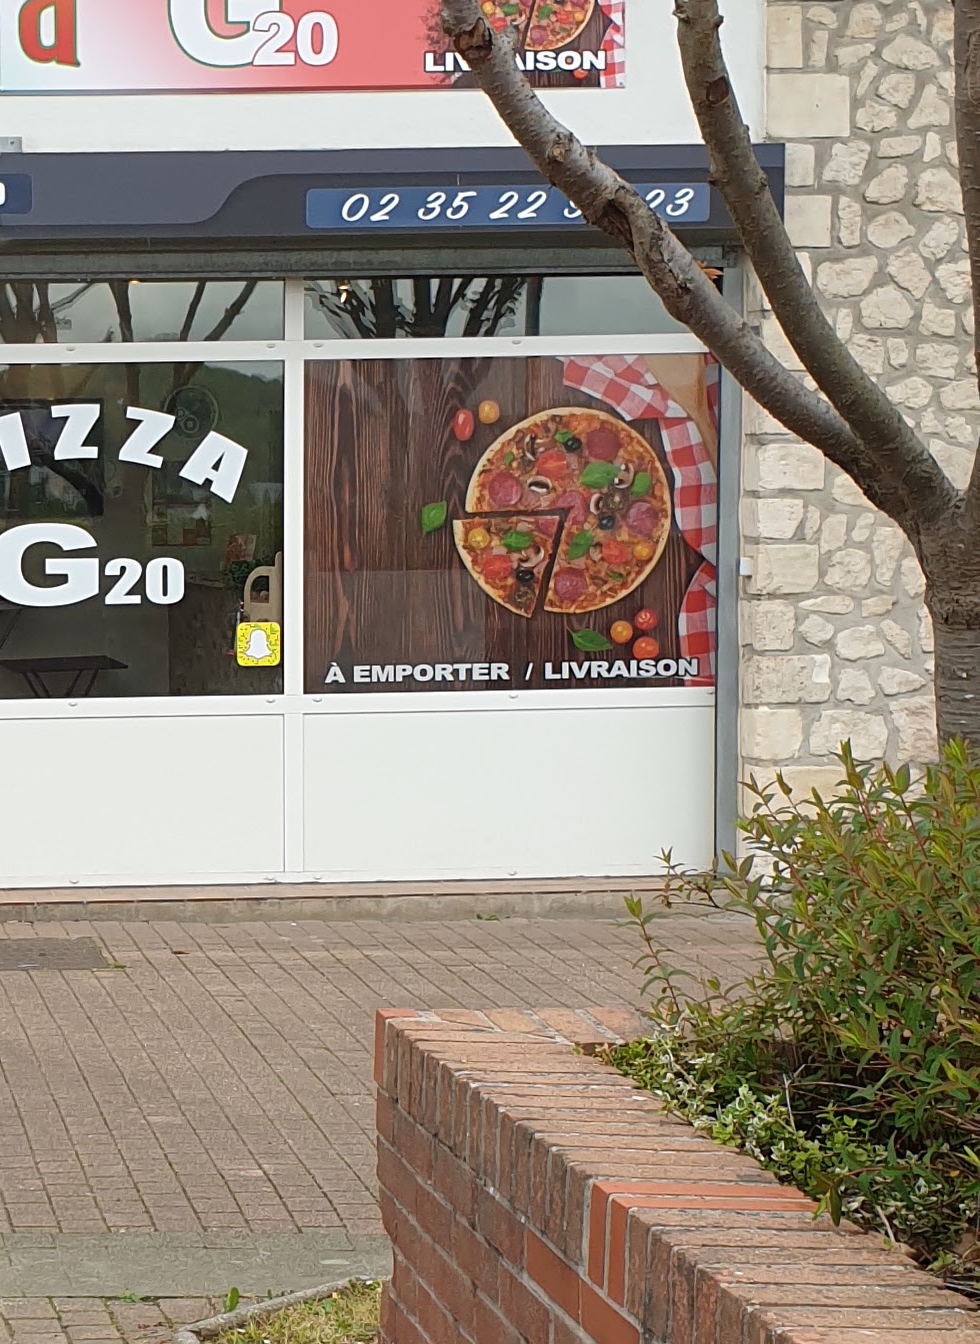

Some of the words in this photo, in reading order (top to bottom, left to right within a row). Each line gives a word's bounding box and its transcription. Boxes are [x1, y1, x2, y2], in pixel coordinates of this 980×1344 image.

[425, 50, 607, 72] LIVAISON
[341, 193, 400, 222] 02
[417, 191, 477, 220] 35
[489, 190, 548, 219] 22
[324, 662, 346, 684] À
[353, 663, 510, 683] EMPORTER
[545, 659, 698, 679] LIVRAISON
